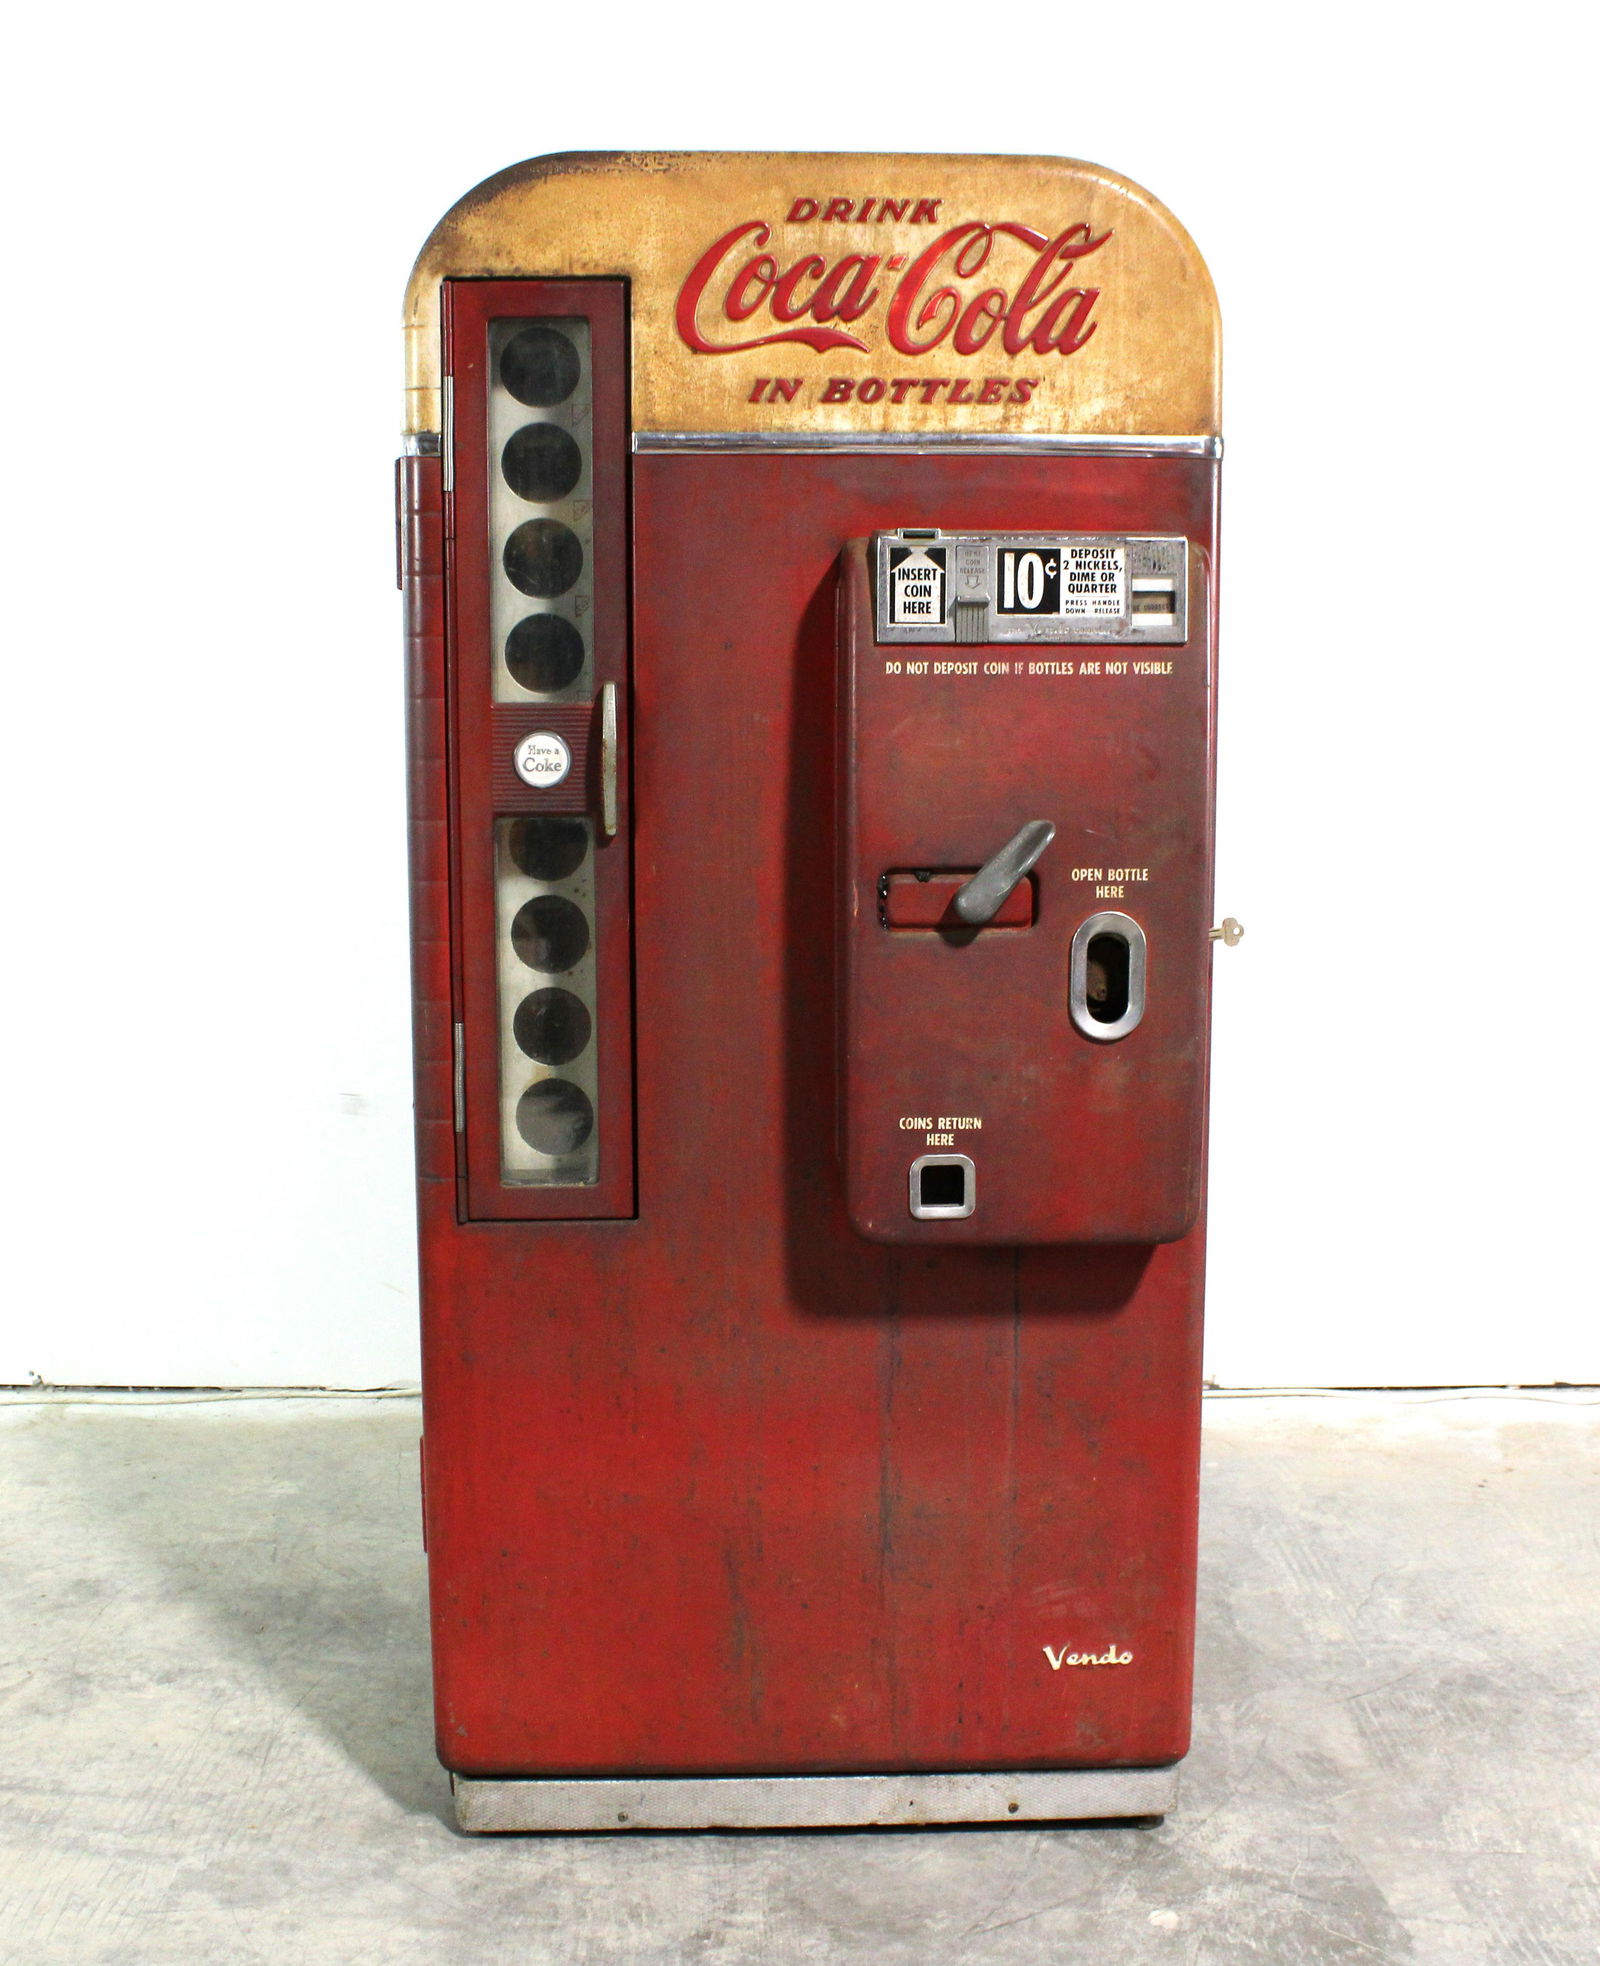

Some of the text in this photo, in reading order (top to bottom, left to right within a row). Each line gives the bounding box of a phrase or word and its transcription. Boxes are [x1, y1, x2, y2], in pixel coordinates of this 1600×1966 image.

[786, 197, 944, 224] DRINK
[674, 220, 1115, 356] Coca-Cola
[748, 377, 1040, 404] IN BOTTLES
[1070, 548, 1116, 559] DEPOSIT
[1062, 560, 1123, 573] 2 NICKELS,
[898, 567, 938, 581] INSERT
[1069, 572, 1115, 582] DIME OR
[904, 584, 932, 598] COIN
[1067, 583, 1117, 595] QUARTER
[903, 601, 932, 615] HERE
[1065, 607, 1121, 615] DOWN RELEASE
[885, 661, 1174, 675] DO NOT DEPOSIT COIN IF BOTTLES ARE NOT VISIBLE
[527, 744, 552, 755] Have
[523, 757, 562, 772] Coke
[1071, 868, 1149, 881] OPEN BOTTLE
[1095, 885, 1125, 898] HERE
[899, 1117, 982, 1130] COINS RETURN
[926, 1133, 955, 1146] HERE
[1042, 1641, 1134, 1671] Vendo
